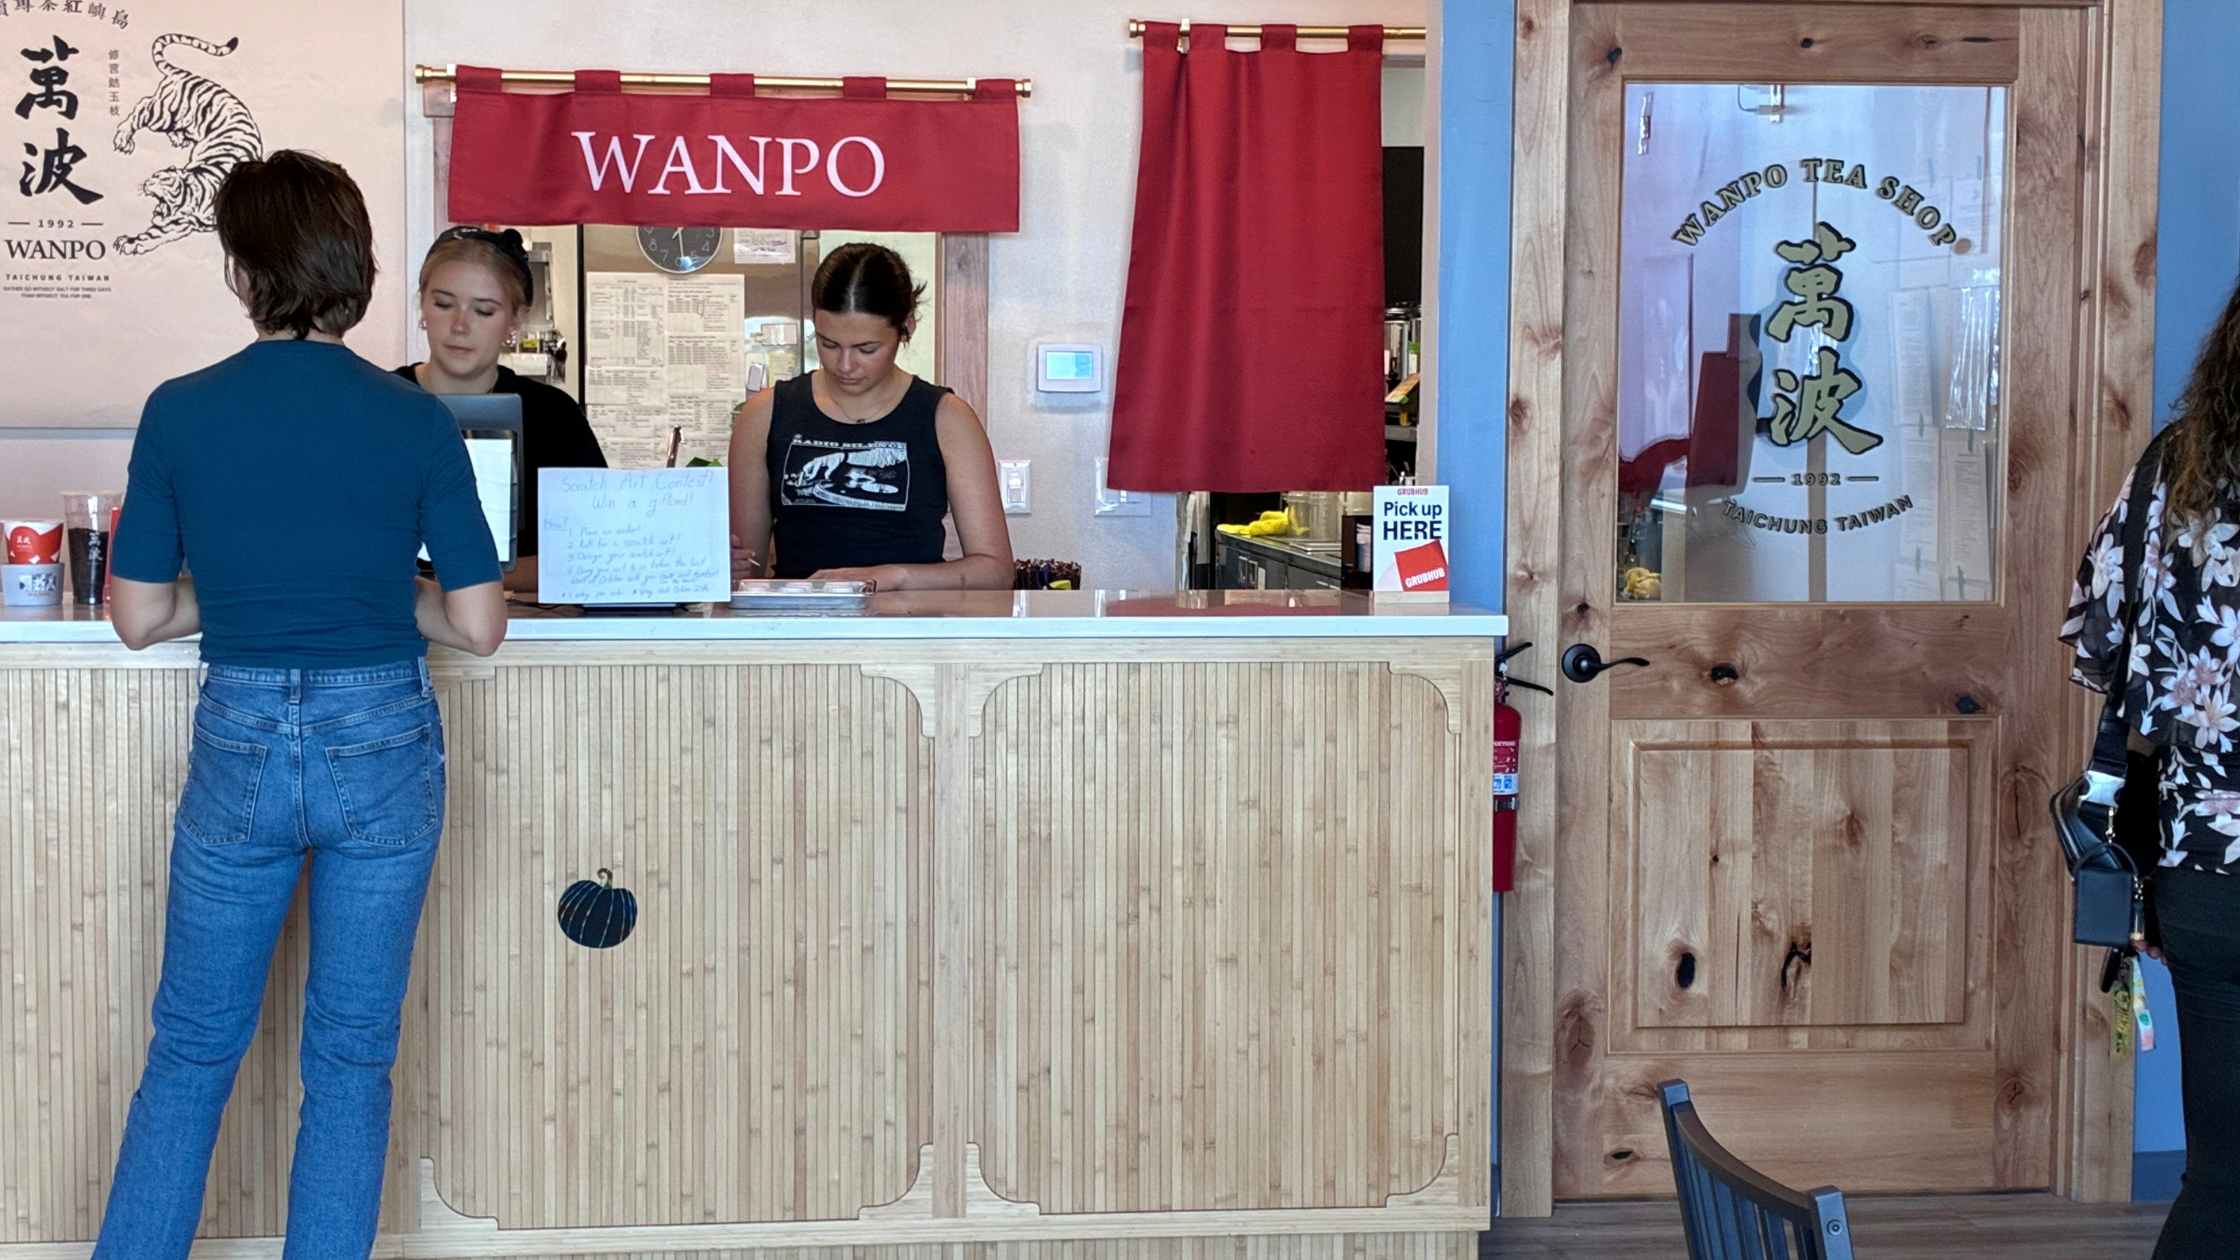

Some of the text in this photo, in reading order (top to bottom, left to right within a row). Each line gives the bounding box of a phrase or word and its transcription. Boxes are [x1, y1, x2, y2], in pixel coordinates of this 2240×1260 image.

[15, 35, 104, 205] 萬波
[571, 132, 885, 197] WANPO
[1670, 158, 1957, 247] WANPO TEA SHOP
[38, 219, 74, 228] 1992
[4, 239, 106, 260] WANPO
[1765, 221, 1884, 455] 萬波
[561, 469, 714, 492] Scratch Art Contest!
[1791, 472, 1841, 487] 1992
[592, 494, 615, 509] Win
[628, 500, 638, 509] a
[1397, 488, 1429, 496] GRUBHUB
[1383, 501, 1443, 520] Pick up
[1721, 495, 1914, 534] TAICHUNG TAIWAN
[1383, 520, 1443, 540] HERE
[1404, 567, 1446, 588] GRUBHUB
